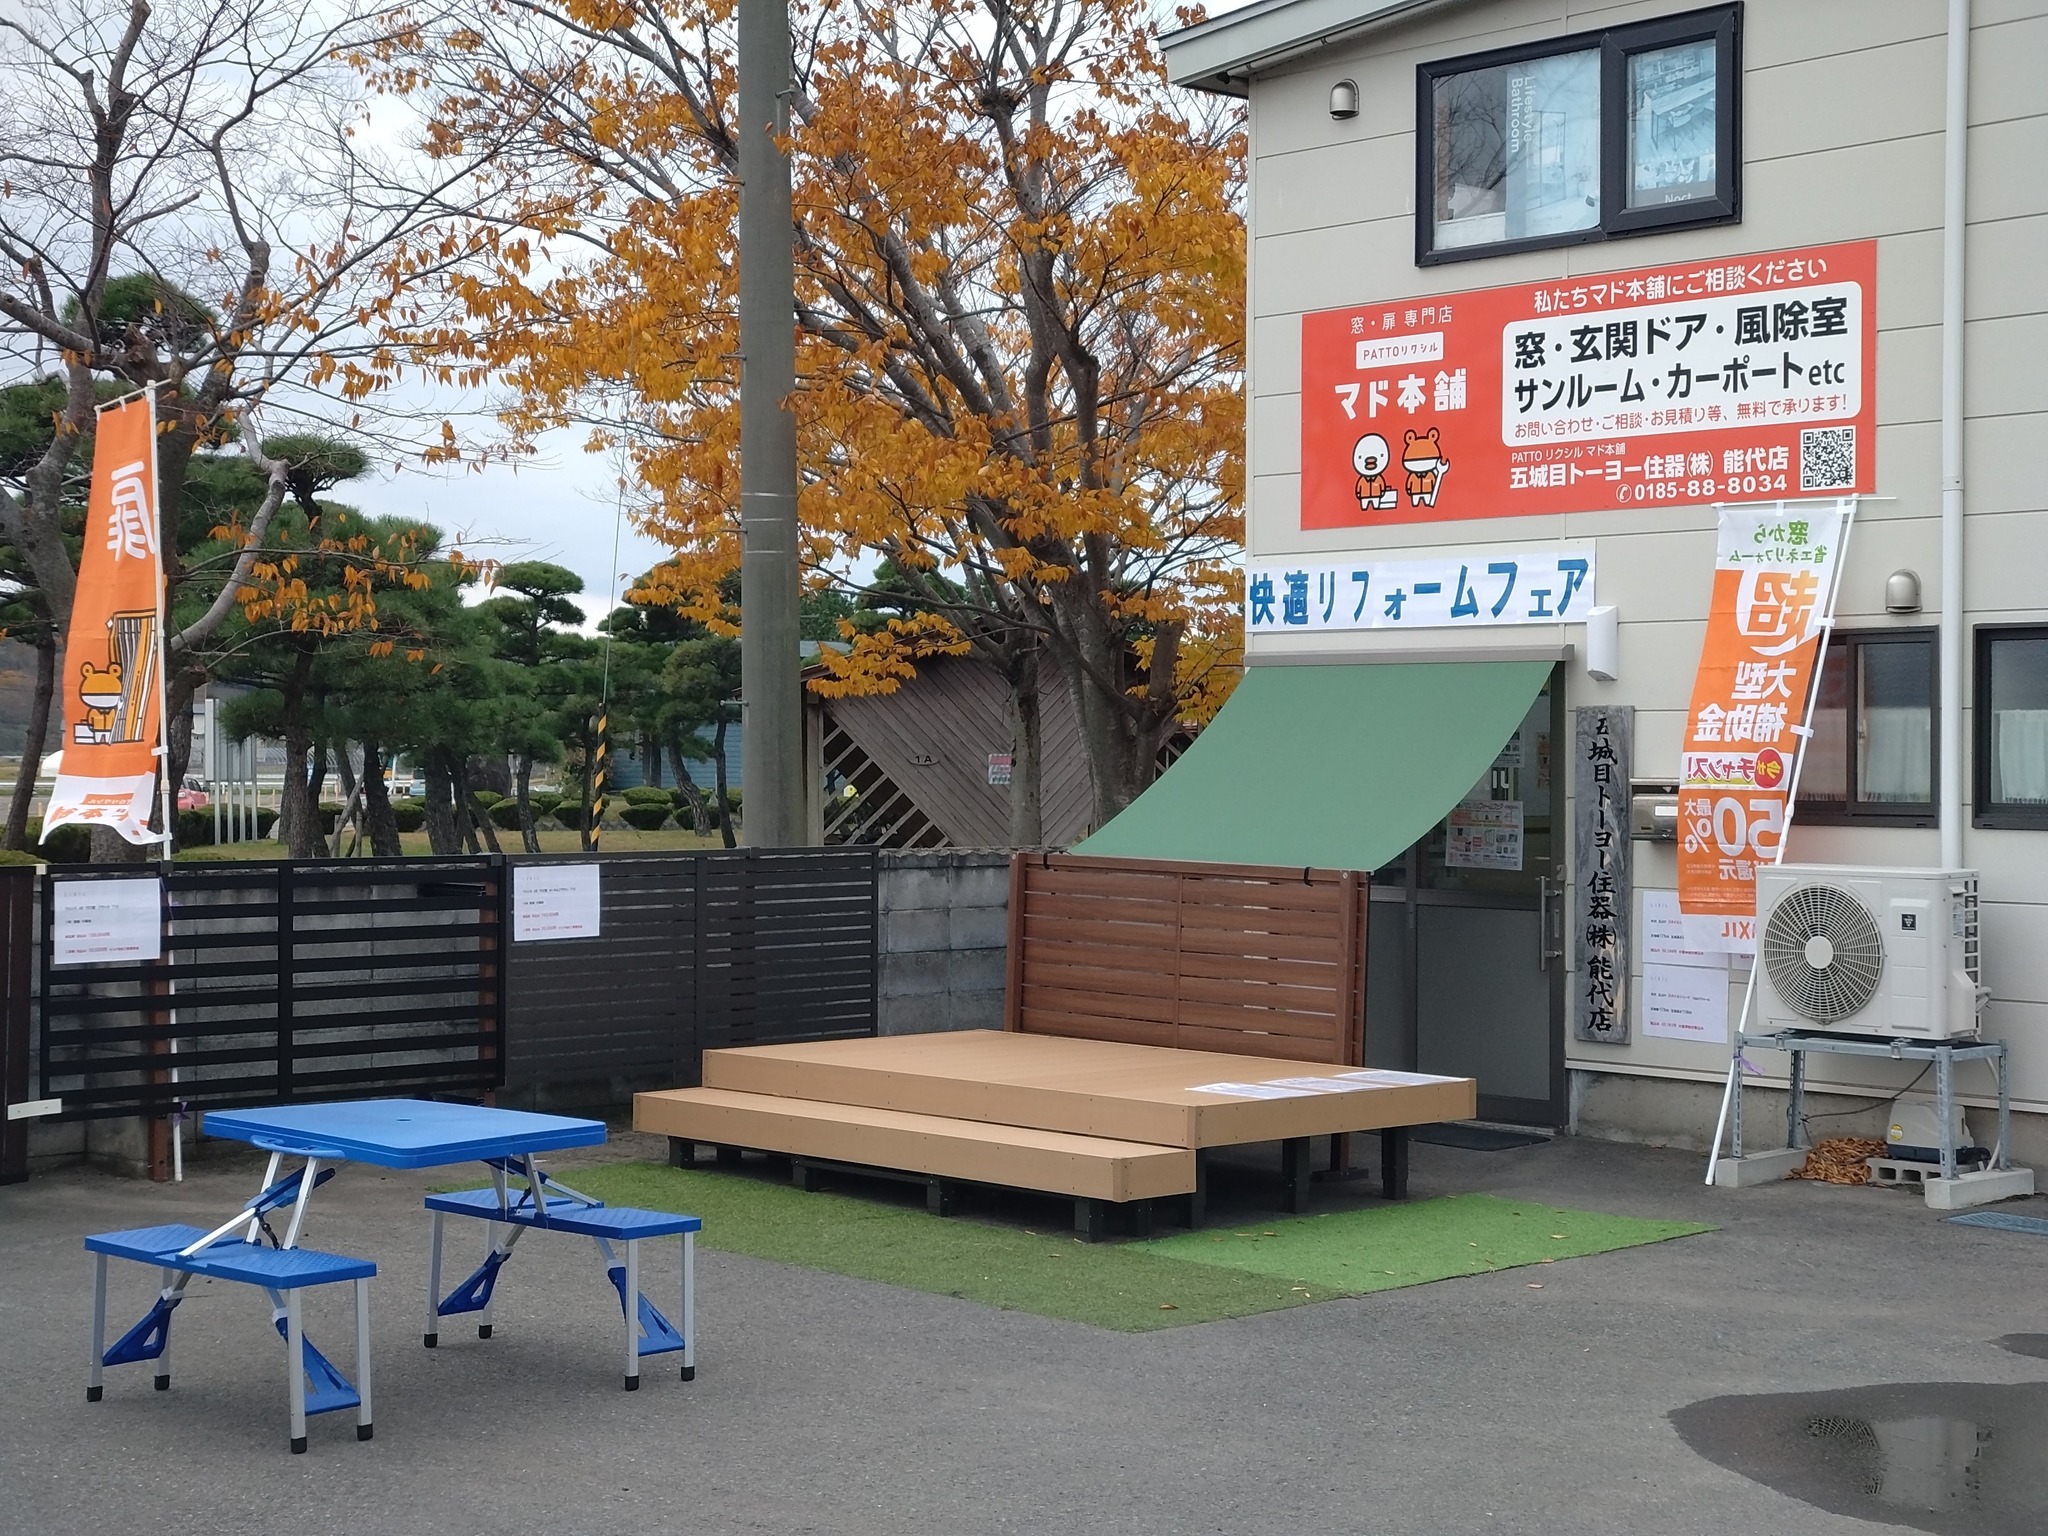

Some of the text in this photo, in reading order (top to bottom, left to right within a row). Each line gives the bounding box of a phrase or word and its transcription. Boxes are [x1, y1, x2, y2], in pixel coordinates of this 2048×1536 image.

[1511, 77, 1523, 153] Bathroom
[1522, 75, 1536, 142] Lifestyle
[1533, 257, 1827, 314] 私たちマド本舗にご相談ください
[1334, 367, 1467, 420] マド本舗
[1634, 475, 1788, 501] 0185-88-8034
[1250, 558, 1589, 625] 快適リフォームフェア
